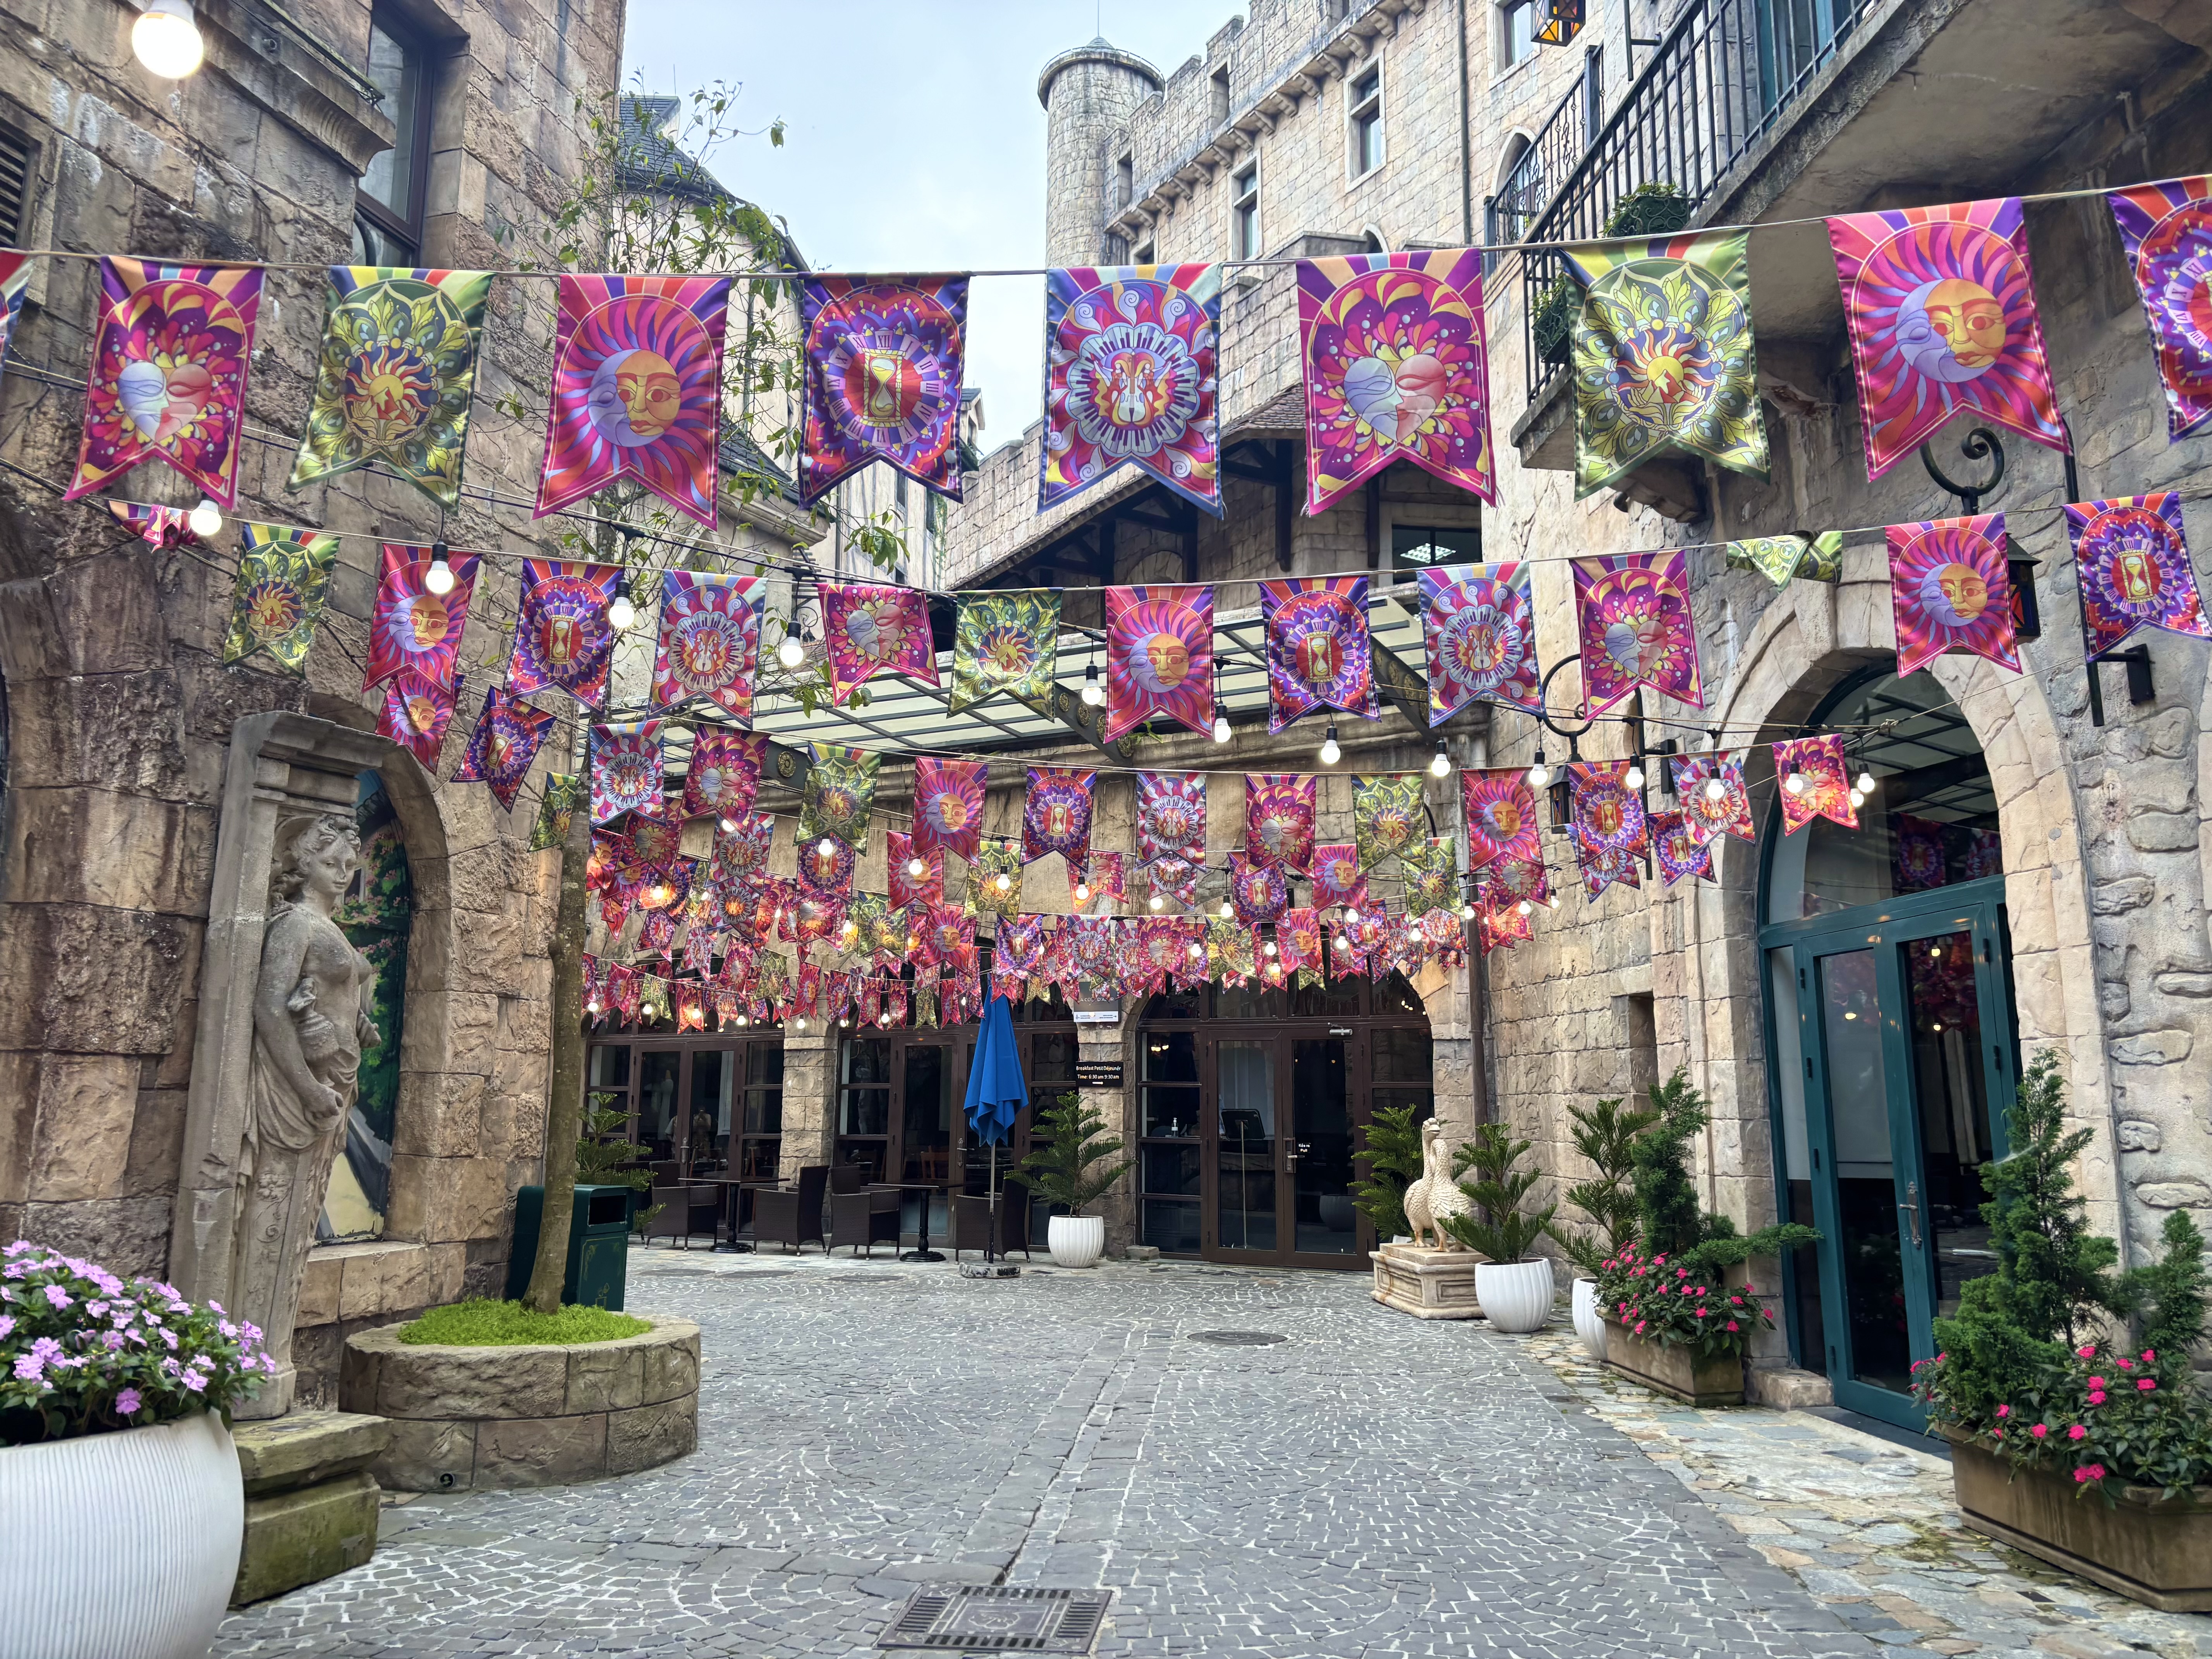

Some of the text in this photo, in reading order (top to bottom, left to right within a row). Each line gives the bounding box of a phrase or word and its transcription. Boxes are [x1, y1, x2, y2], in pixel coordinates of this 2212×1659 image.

[852, 337, 864, 347] XI
[878, 335, 890, 348] XII
[906, 340, 914, 353] I
[836, 354, 848, 364] X
[919, 361, 932, 370] II
[827, 378, 840, 388] IX
[926, 383, 939, 393] III
[831, 399, 846, 417] VIII
[919, 405, 933, 420] IV
[848, 422, 860, 437] VII
[876, 429, 886, 443] VI
[905, 426, 913, 439] V
